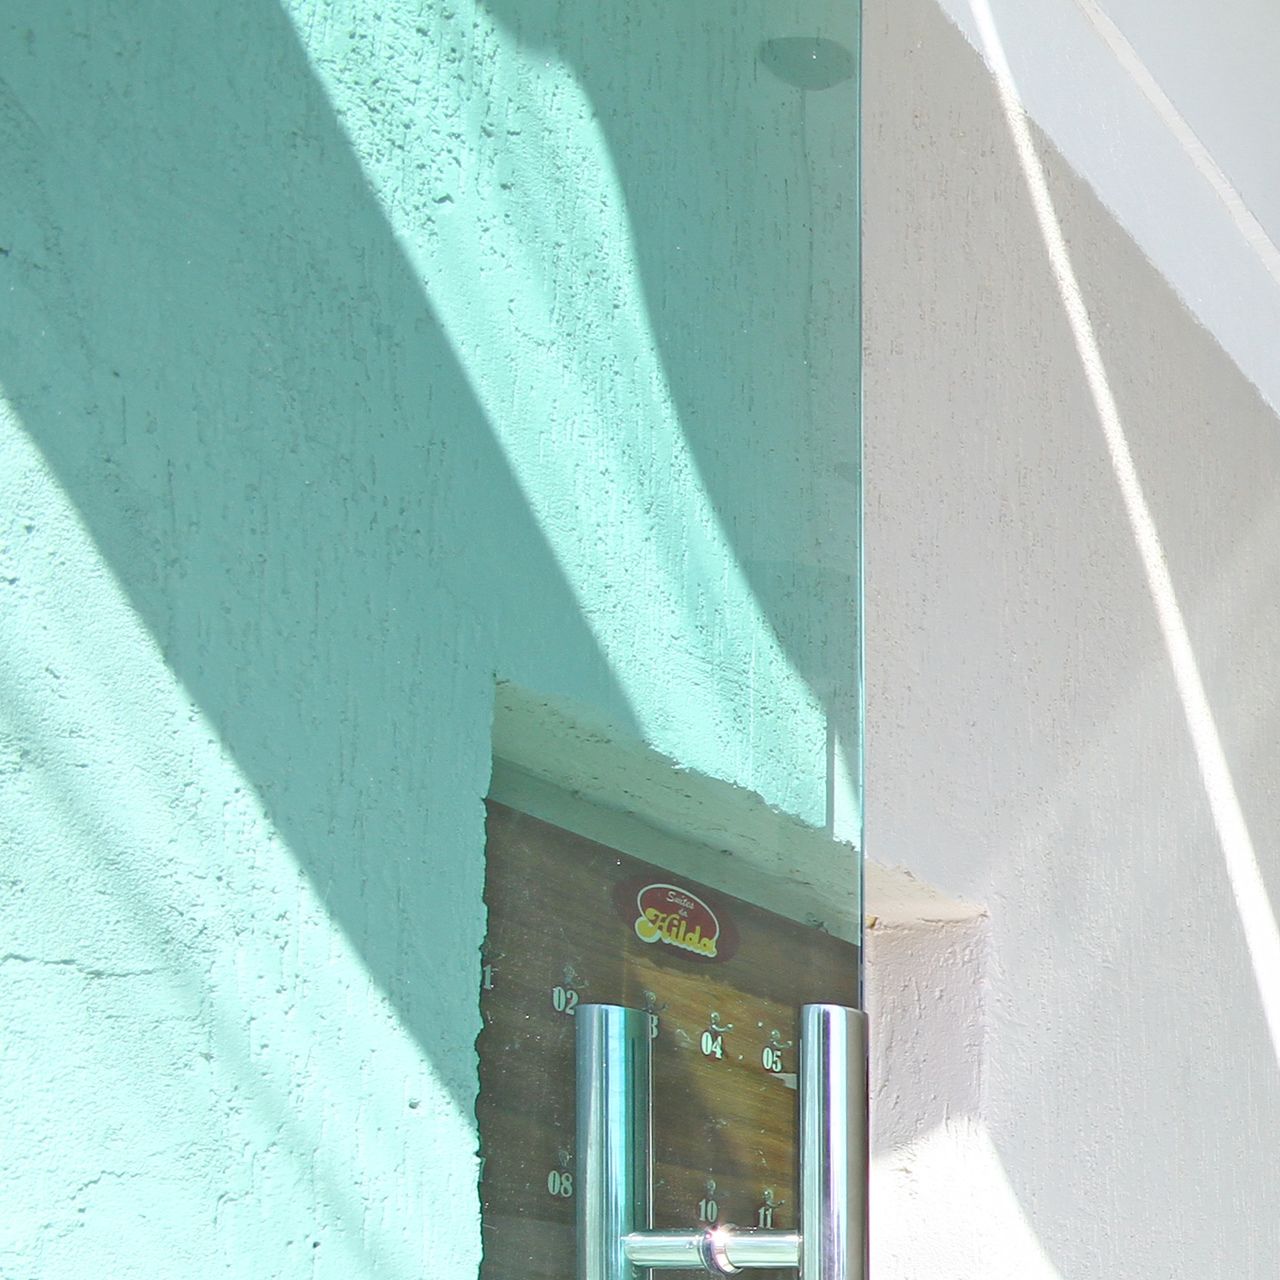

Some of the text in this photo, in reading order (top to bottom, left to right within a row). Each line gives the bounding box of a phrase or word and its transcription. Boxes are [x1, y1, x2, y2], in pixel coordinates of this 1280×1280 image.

[636, 907, 717, 957] Hilda
[553, 986, 579, 1015] 02
[701, 1031, 723, 1059] 04
[762, 1047, 782, 1072] 05
[547, 1170, 573, 1197] 08
[698, 1198, 718, 1222] 10
[758, 1206, 776, 1230] 11
